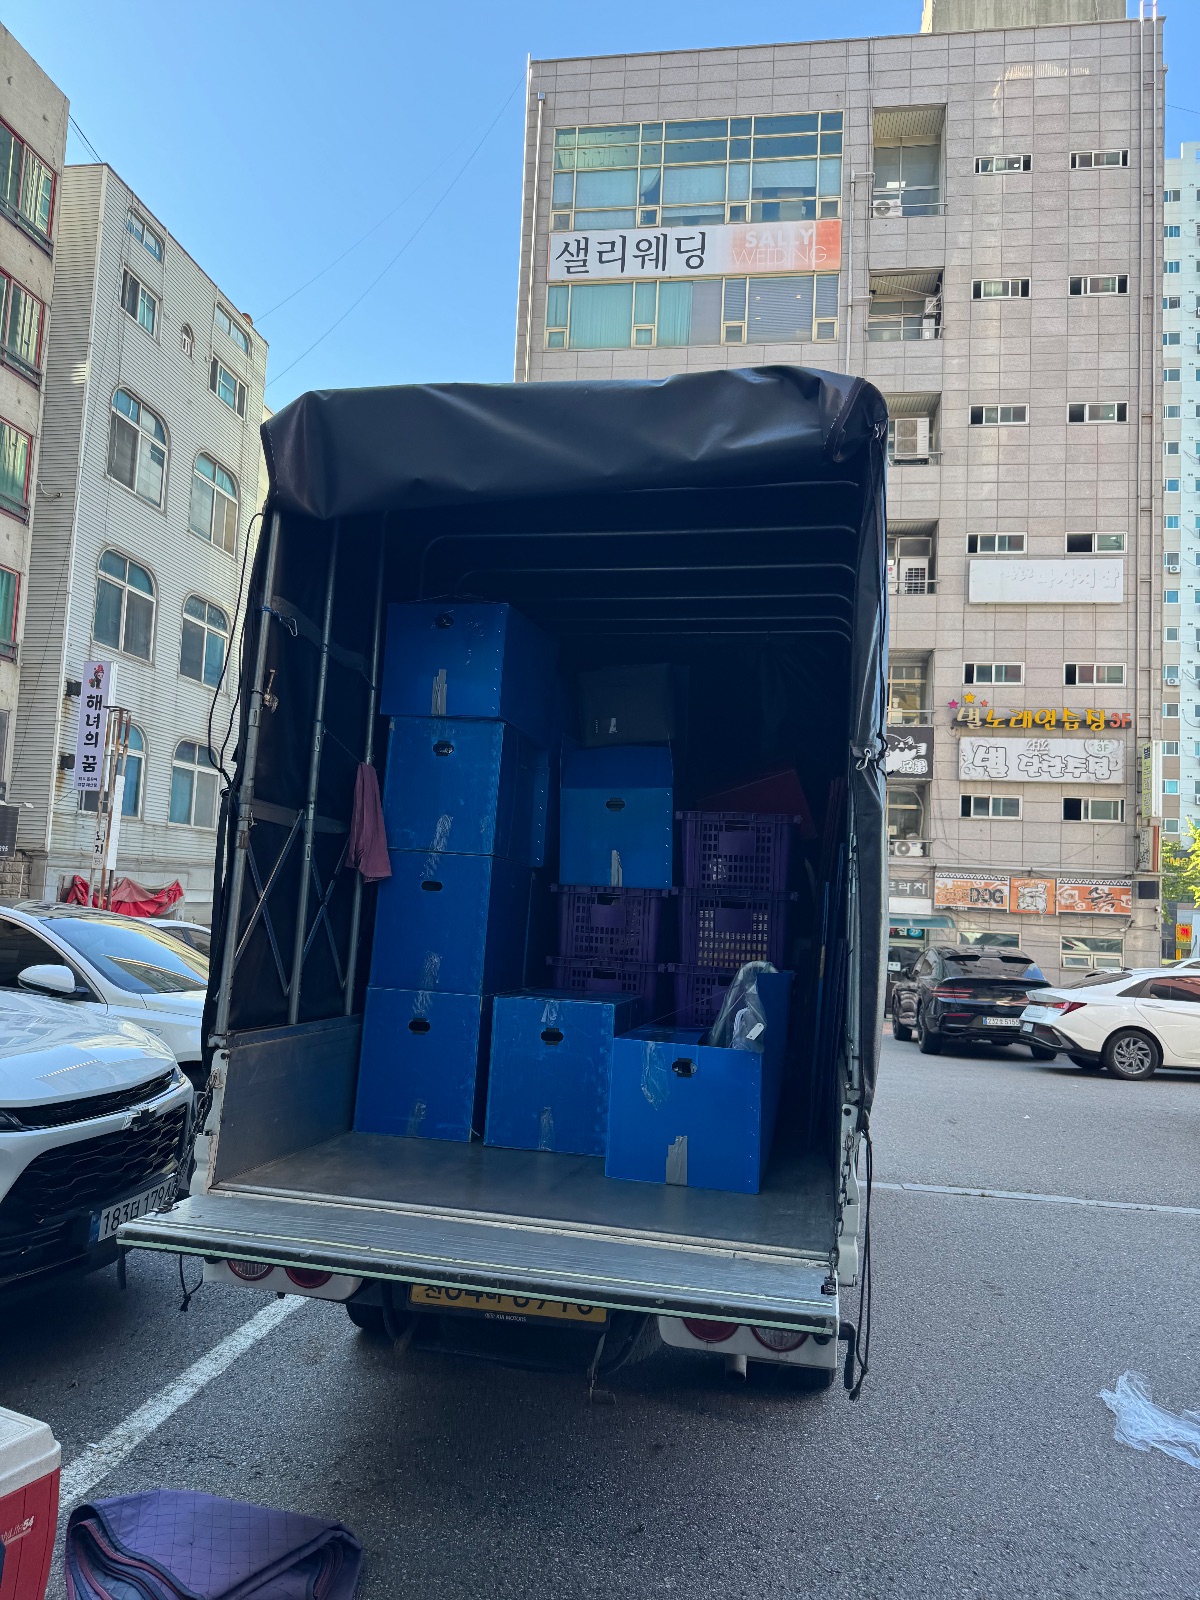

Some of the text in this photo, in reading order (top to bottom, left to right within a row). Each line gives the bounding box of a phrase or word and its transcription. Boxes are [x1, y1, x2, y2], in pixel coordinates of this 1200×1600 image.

[745, 228, 814, 248] SALLY
[555, 231, 706, 275] 샐리웨딩
[732, 245, 827, 266] WEDDING
[83, 693, 103, 748] 해녀의
[1109, 712, 1132, 729] 3F
[1096, 740, 1110, 754] 3F
[81, 754, 97, 773] 꿈
